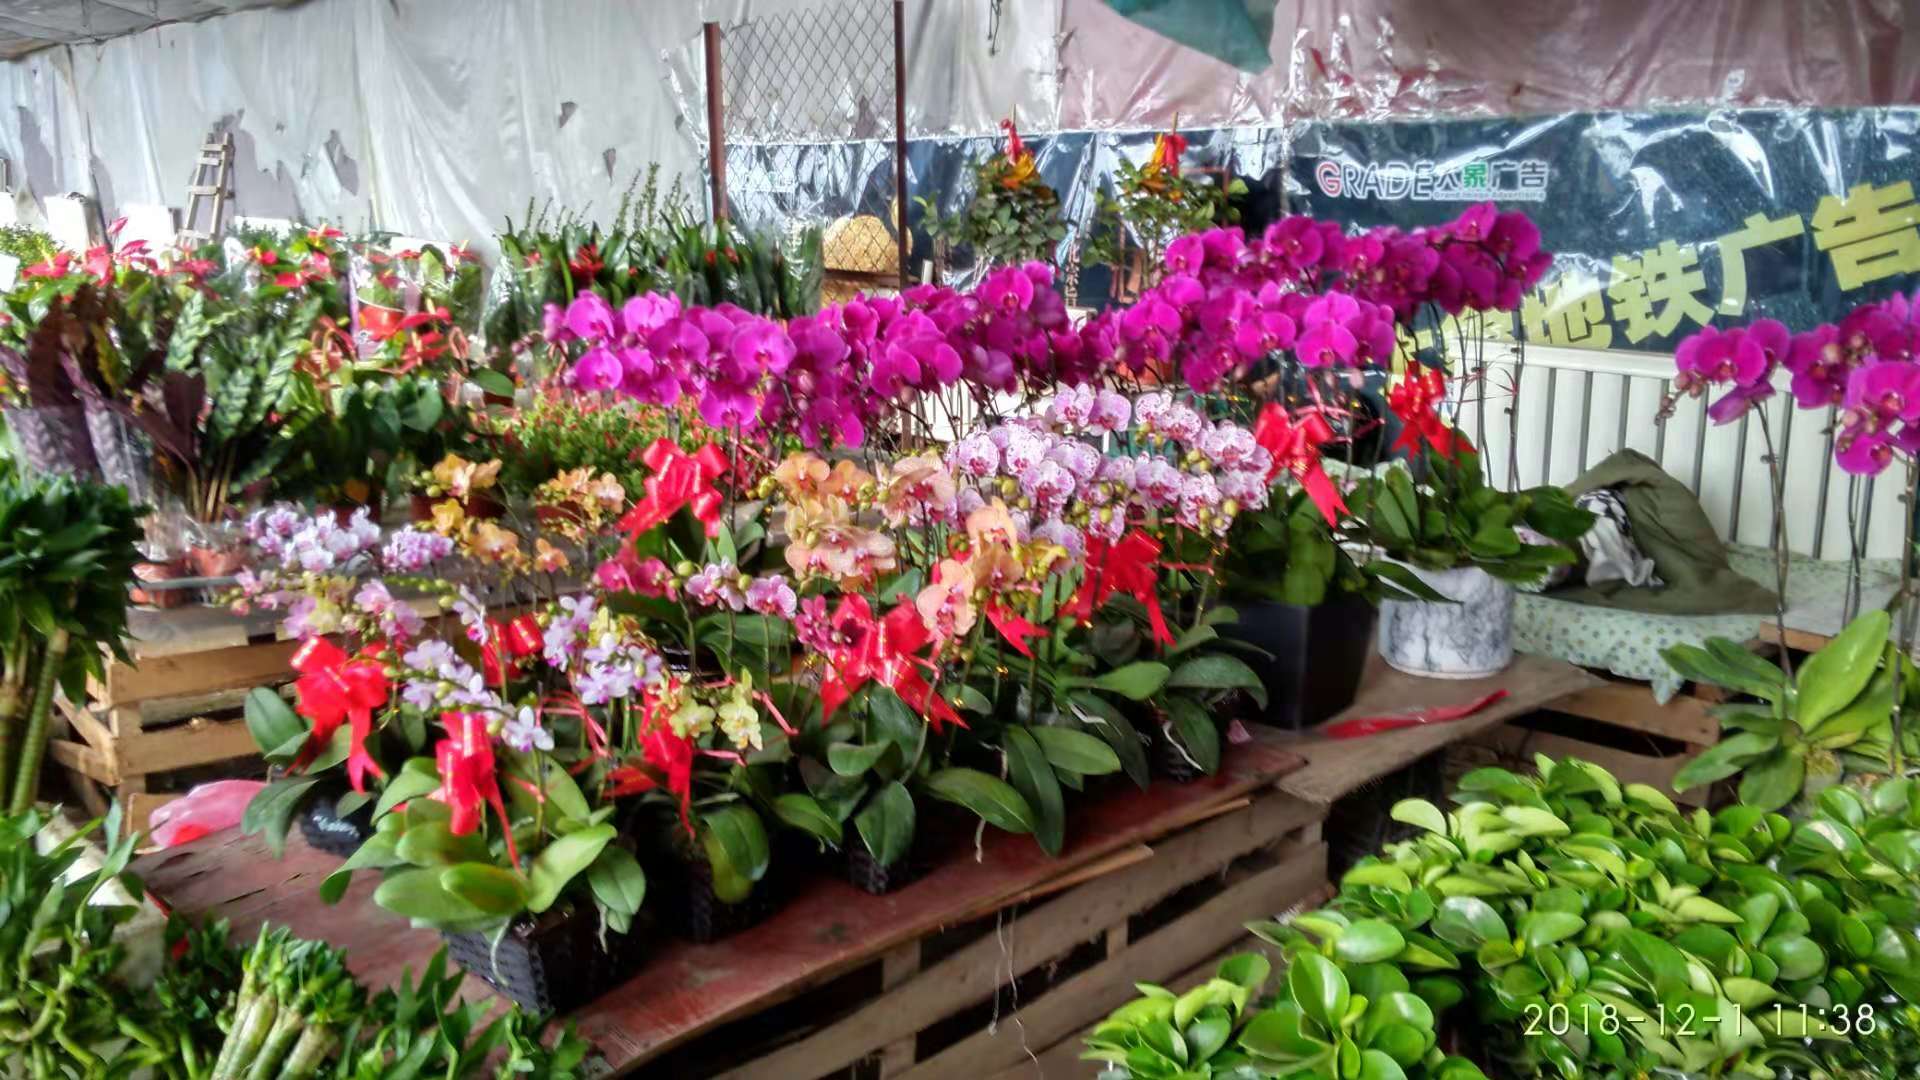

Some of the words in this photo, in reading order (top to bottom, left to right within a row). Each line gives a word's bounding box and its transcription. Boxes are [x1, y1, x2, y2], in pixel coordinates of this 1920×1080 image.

[1316, 160, 1434, 200] GRADE
[1396, 180, 1920, 362] 地铁广告
